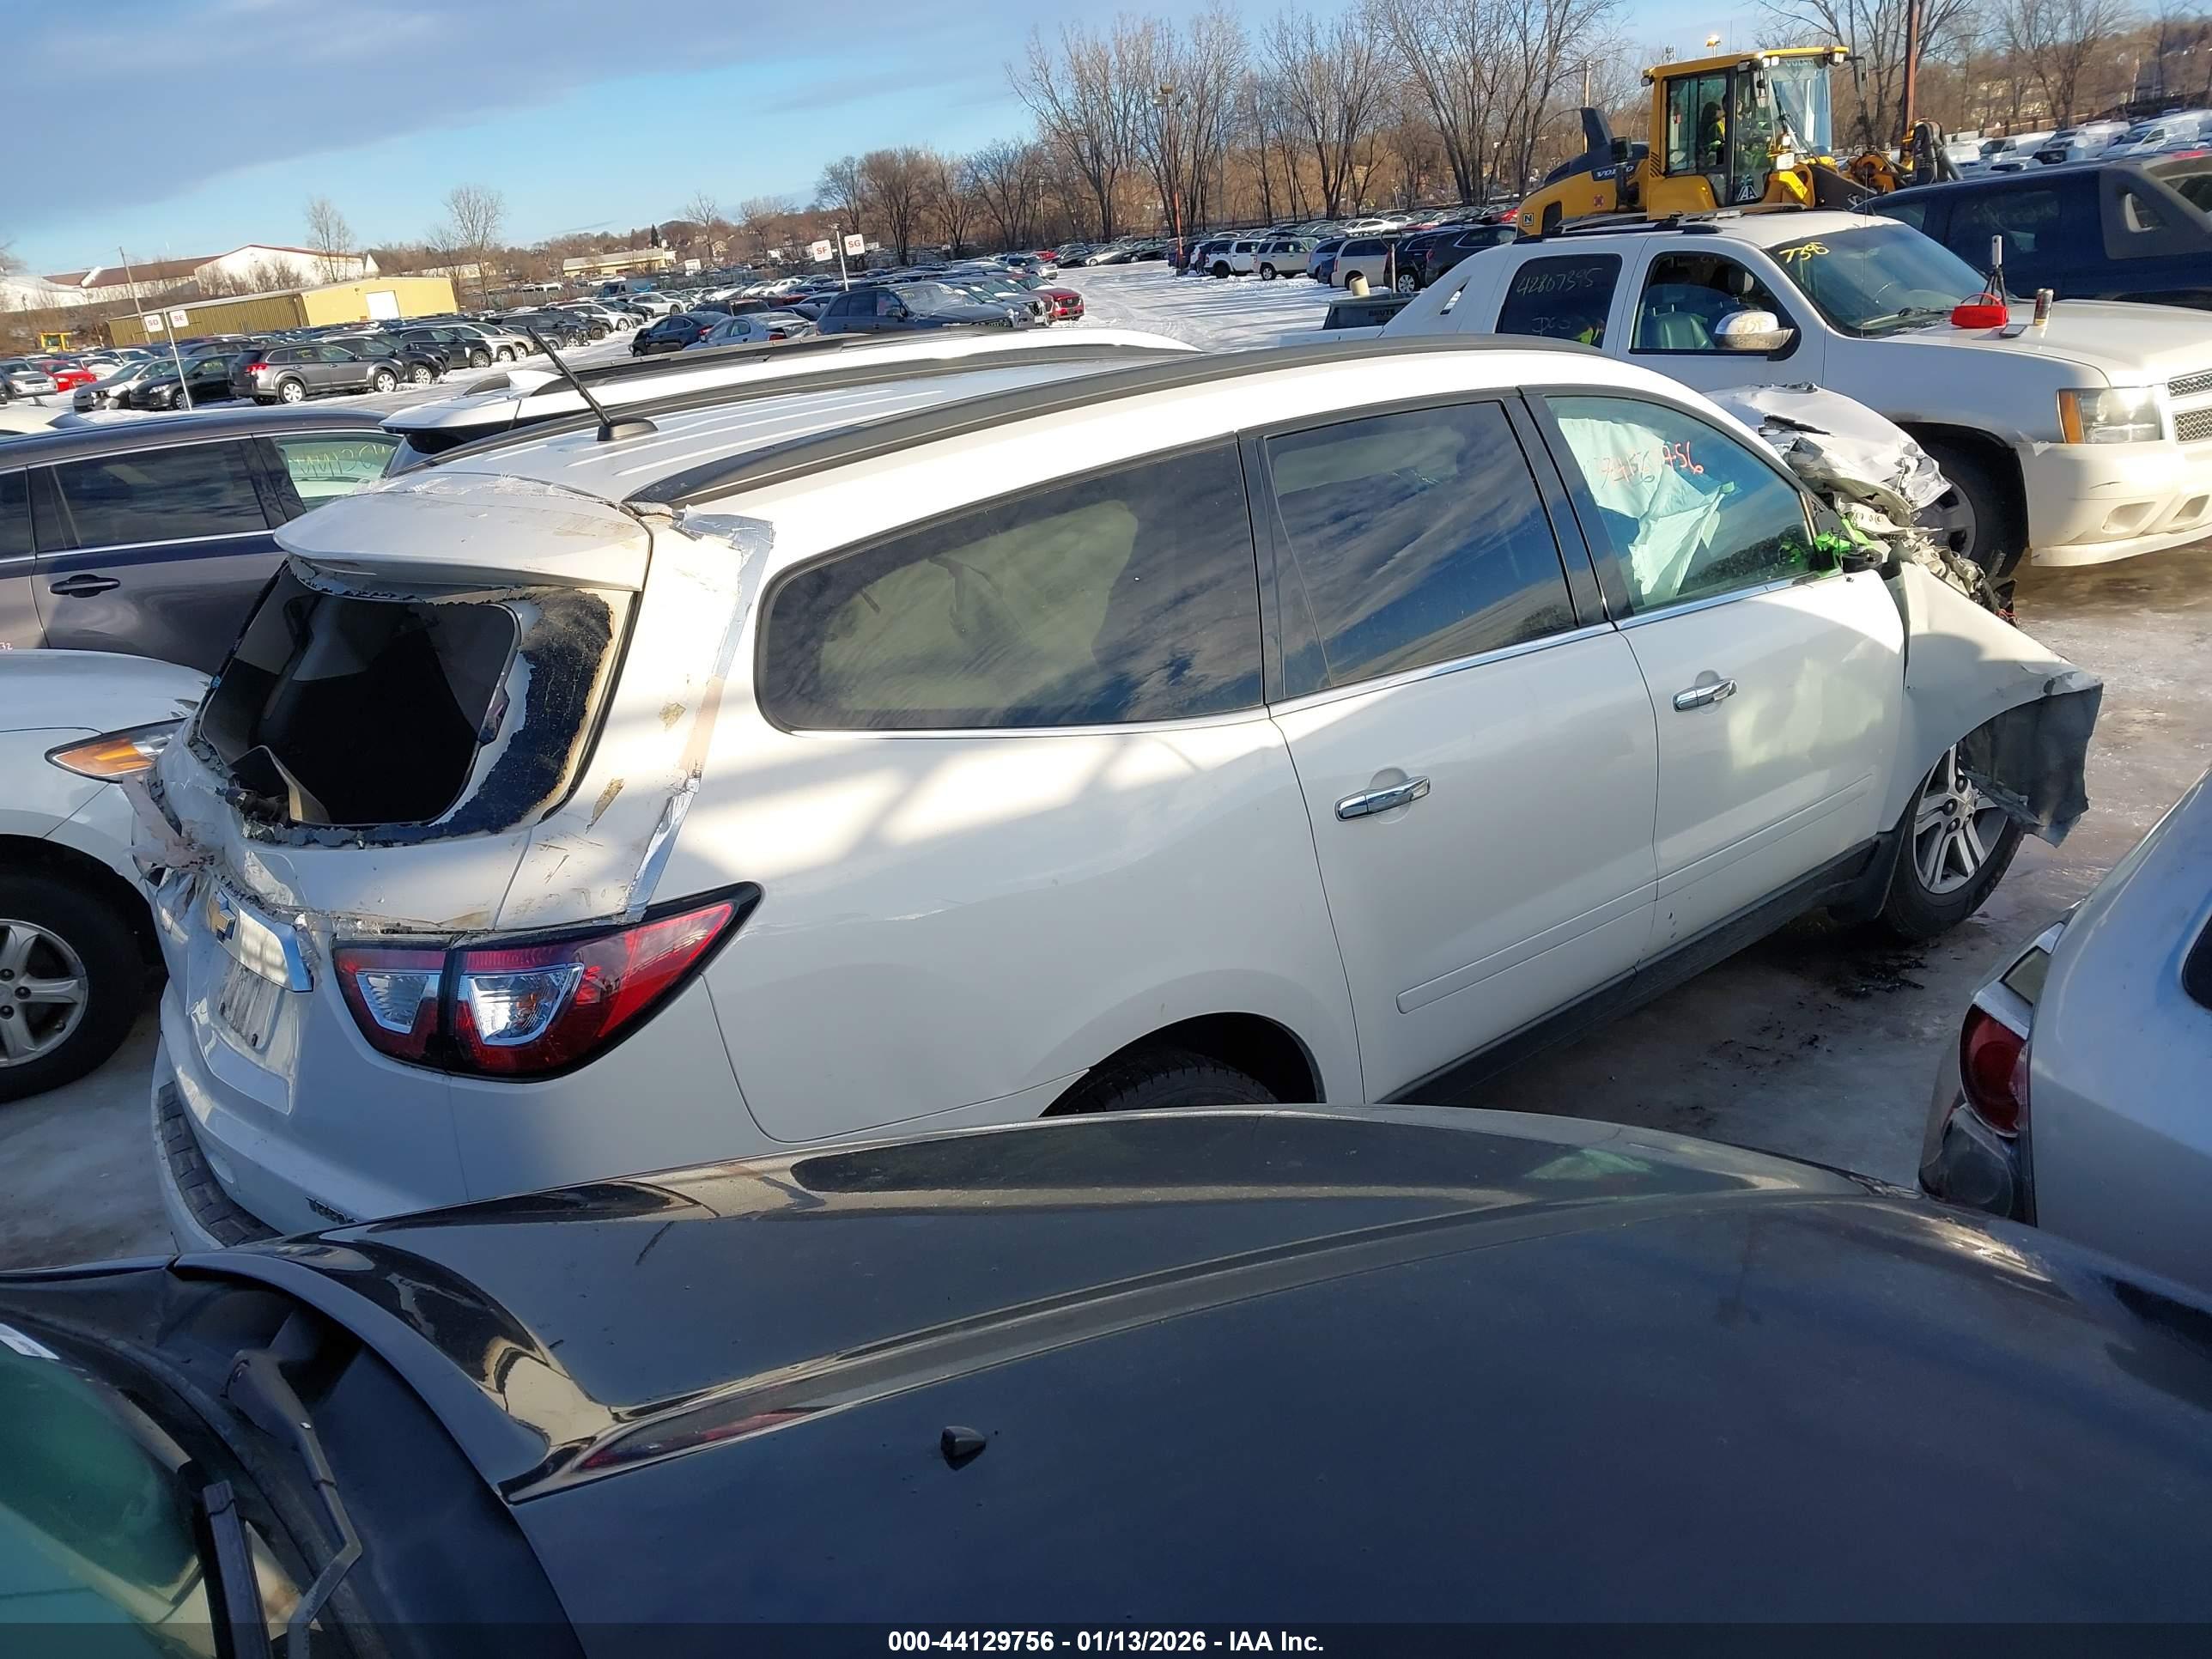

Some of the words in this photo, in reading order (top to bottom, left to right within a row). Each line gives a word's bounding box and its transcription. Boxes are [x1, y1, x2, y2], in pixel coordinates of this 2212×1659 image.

[1596, 166, 1635, 177] VOLO
[848, 240, 861, 248] SG
[816, 246, 829, 255] SF
